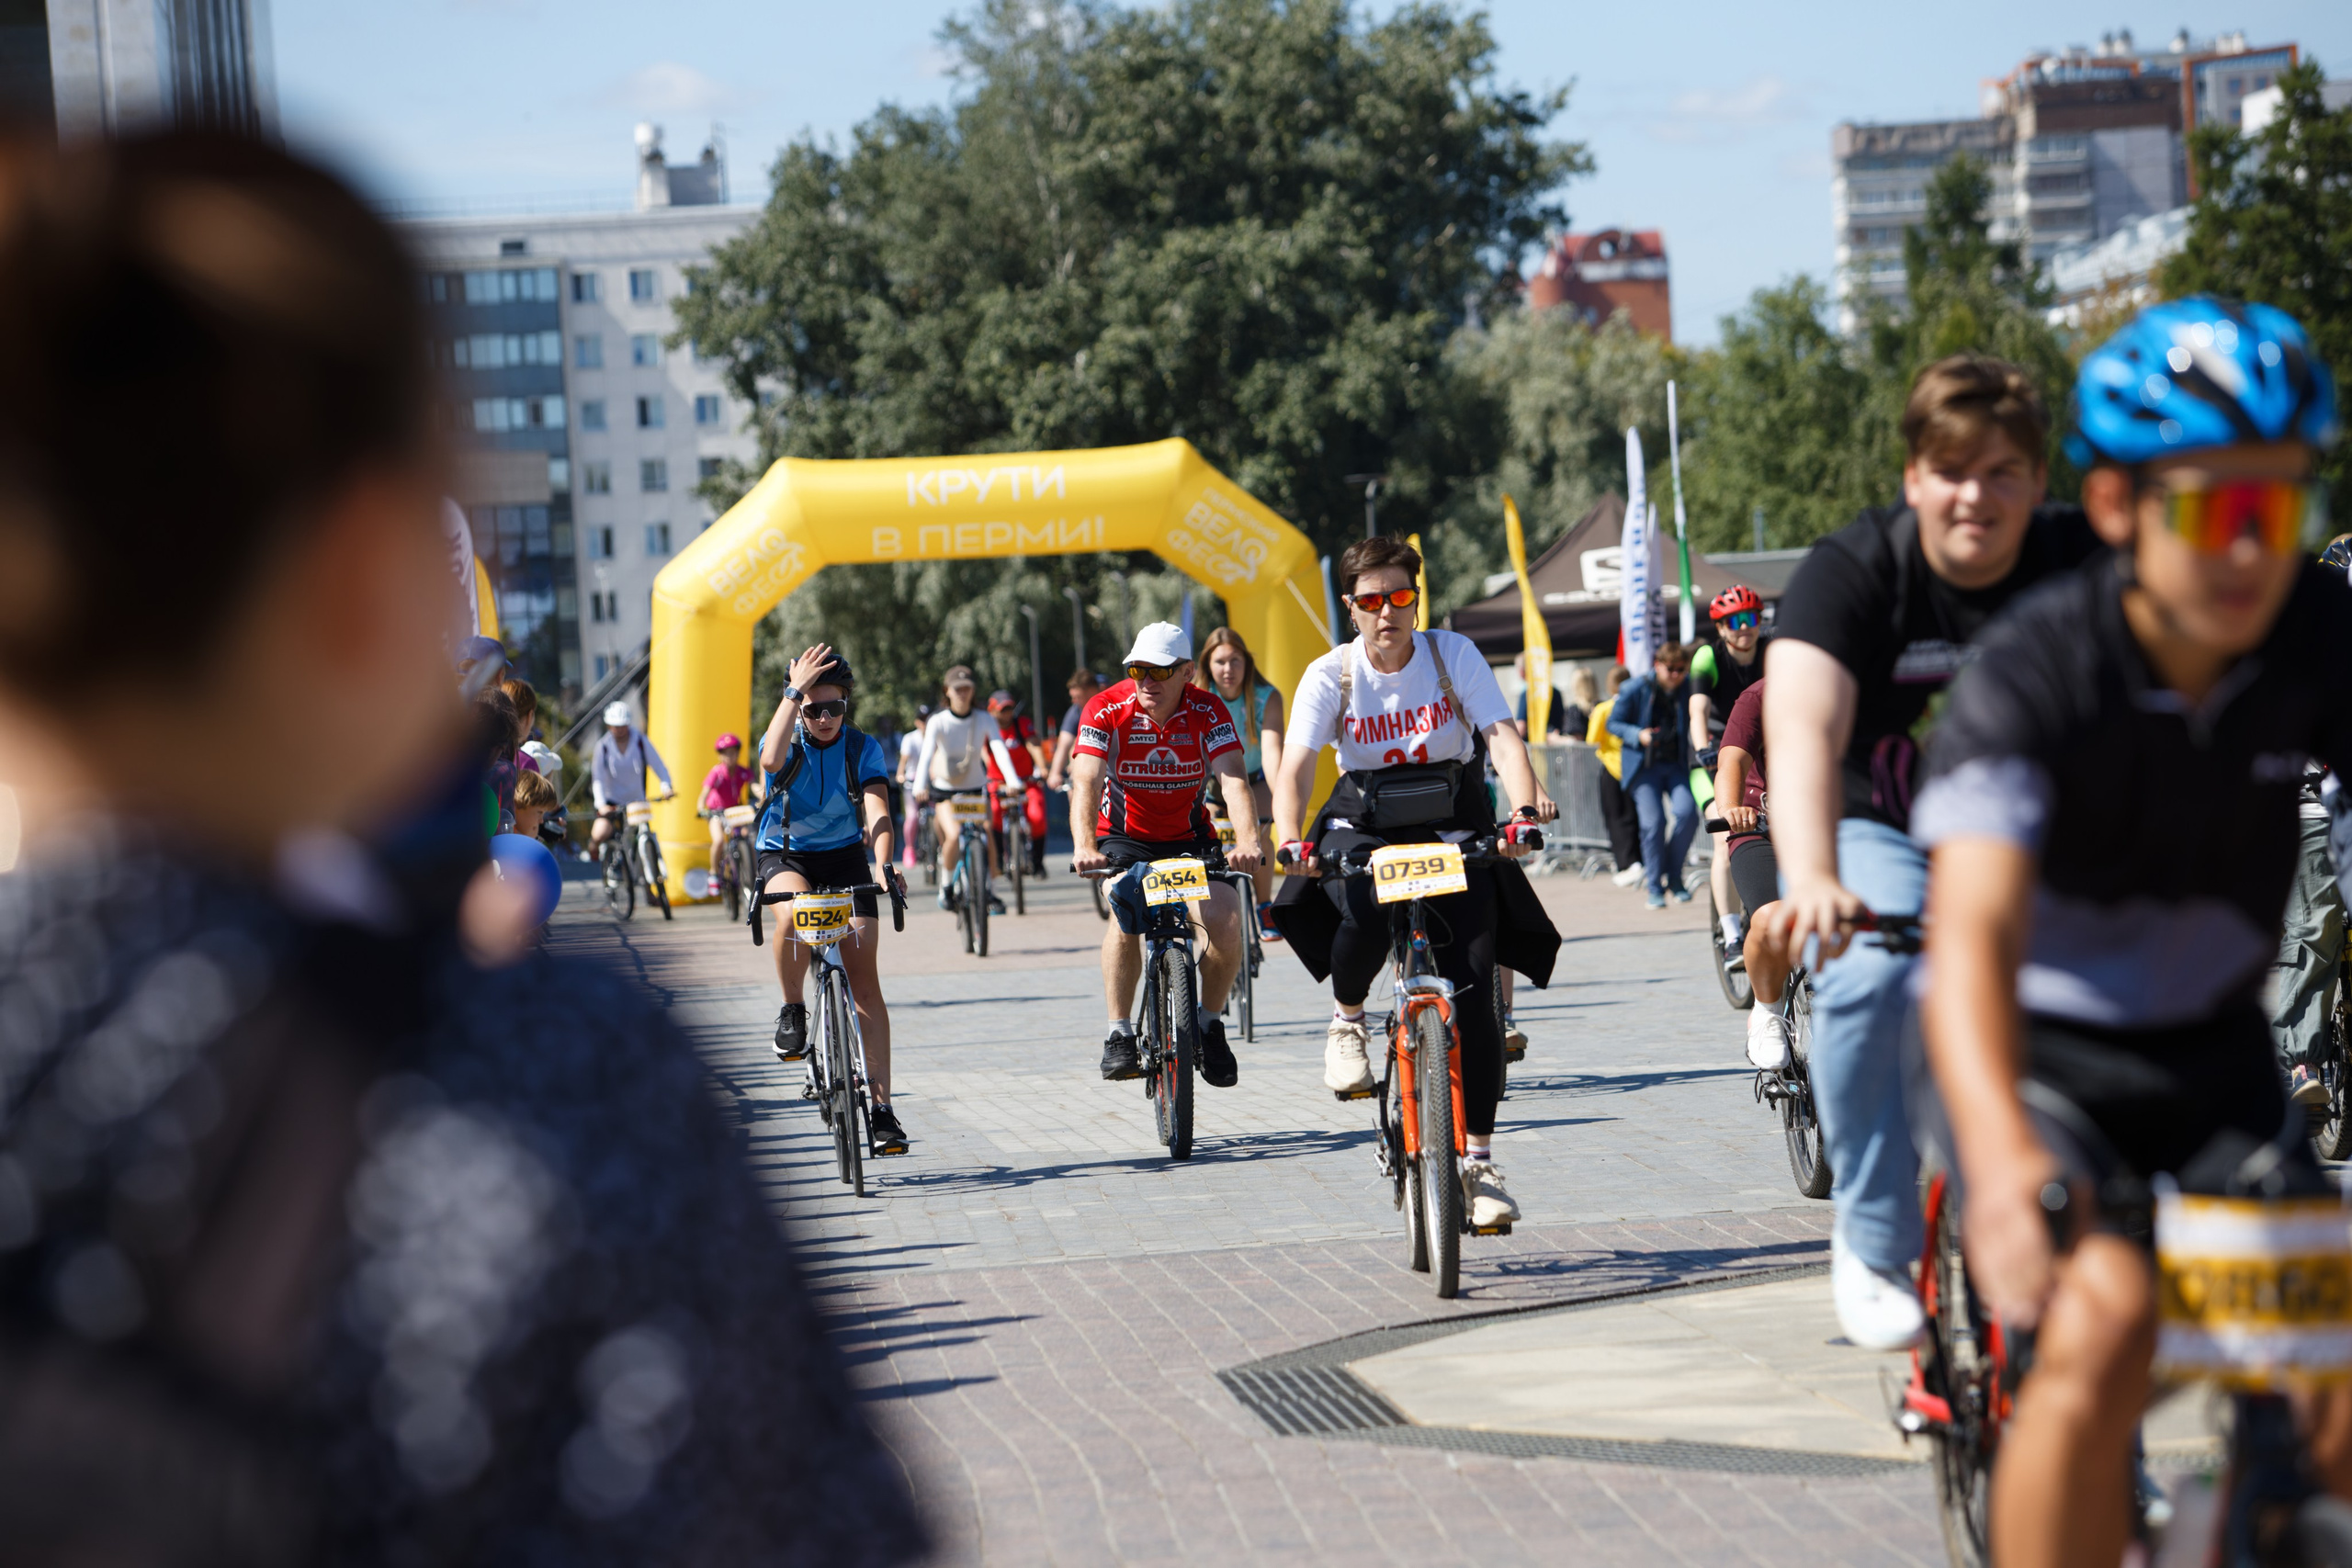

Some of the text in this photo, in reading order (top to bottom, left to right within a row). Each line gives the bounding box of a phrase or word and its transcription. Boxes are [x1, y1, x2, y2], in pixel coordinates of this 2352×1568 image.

[907, 464, 1067, 507] КРУТИ
[872, 515, 1105, 558] В ПЕРМИ!
[1344, 696, 1453, 745] ГИМНАЗИЯ
[1120, 761, 1201, 775] STRUSSNIG
[1166, 780, 1200, 789] GLANZER
[1146, 870, 1197, 890] 0454
[1379, 857, 1445, 881] 0739
[796, 909, 844, 927] 0524
